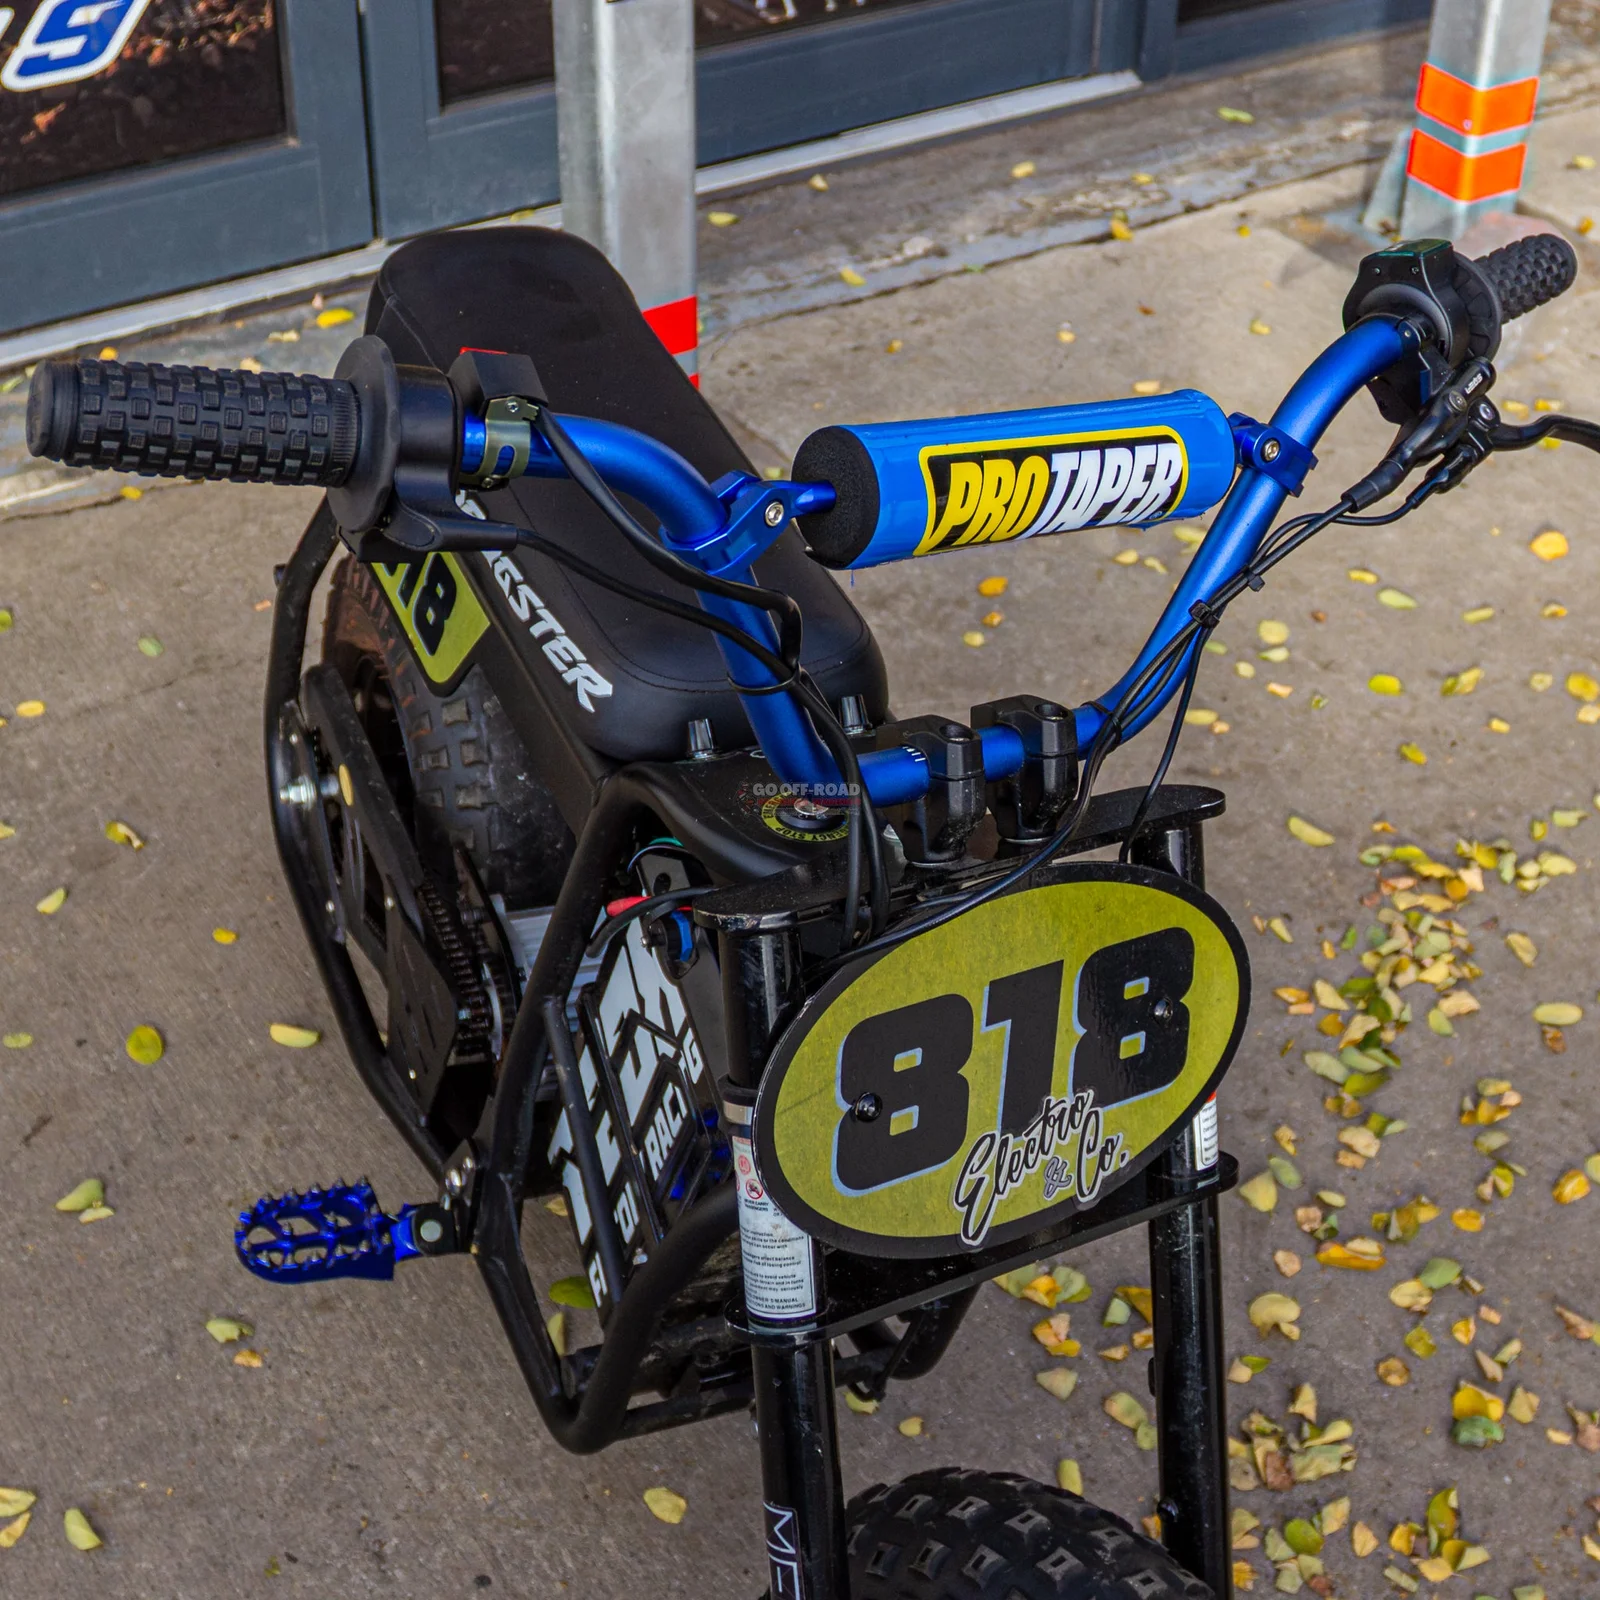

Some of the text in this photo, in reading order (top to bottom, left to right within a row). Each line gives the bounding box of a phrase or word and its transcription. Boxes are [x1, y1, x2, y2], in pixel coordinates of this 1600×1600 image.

[832, 927, 1196, 1197] 818
[954, 1090, 1094, 1246] Electro
[776, 1302, 806, 1310] WARNINGS
